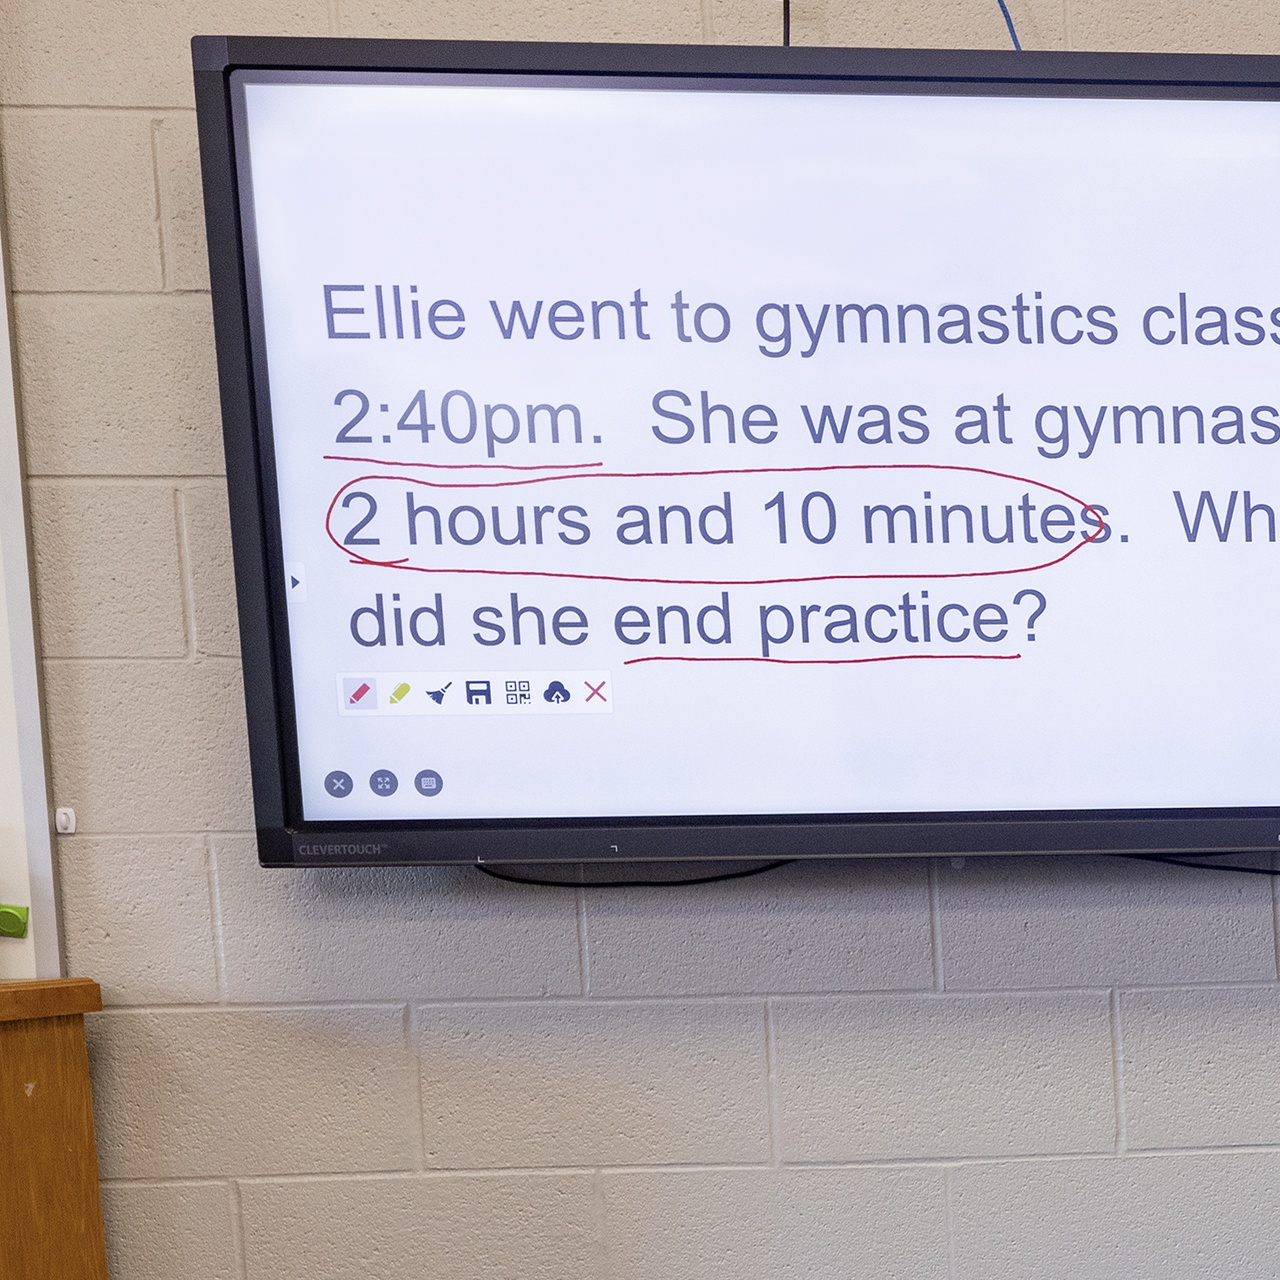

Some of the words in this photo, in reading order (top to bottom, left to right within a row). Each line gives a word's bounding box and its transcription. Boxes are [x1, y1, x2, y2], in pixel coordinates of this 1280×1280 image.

[323, 283, 467, 341] Ellie
[490, 288, 651, 342] went
[673, 289, 732, 344] to
[755, 290, 1119, 358] gymnastics
[333, 388, 604, 458] 2:40pm.
[650, 389, 779, 445] She
[801, 402, 931, 444] was
[954, 392, 1013, 446] at
[342, 491, 381, 546] 2
[407, 491, 591, 546] hours
[615, 491, 734, 546] and
[764, 491, 837, 545] 10
[864, 490, 1130, 544] minutes.
[350, 593, 446, 648] did
[473, 592, 588, 647] she
[616, 592, 731, 646] end
[760, 589, 1047, 656] practice?
